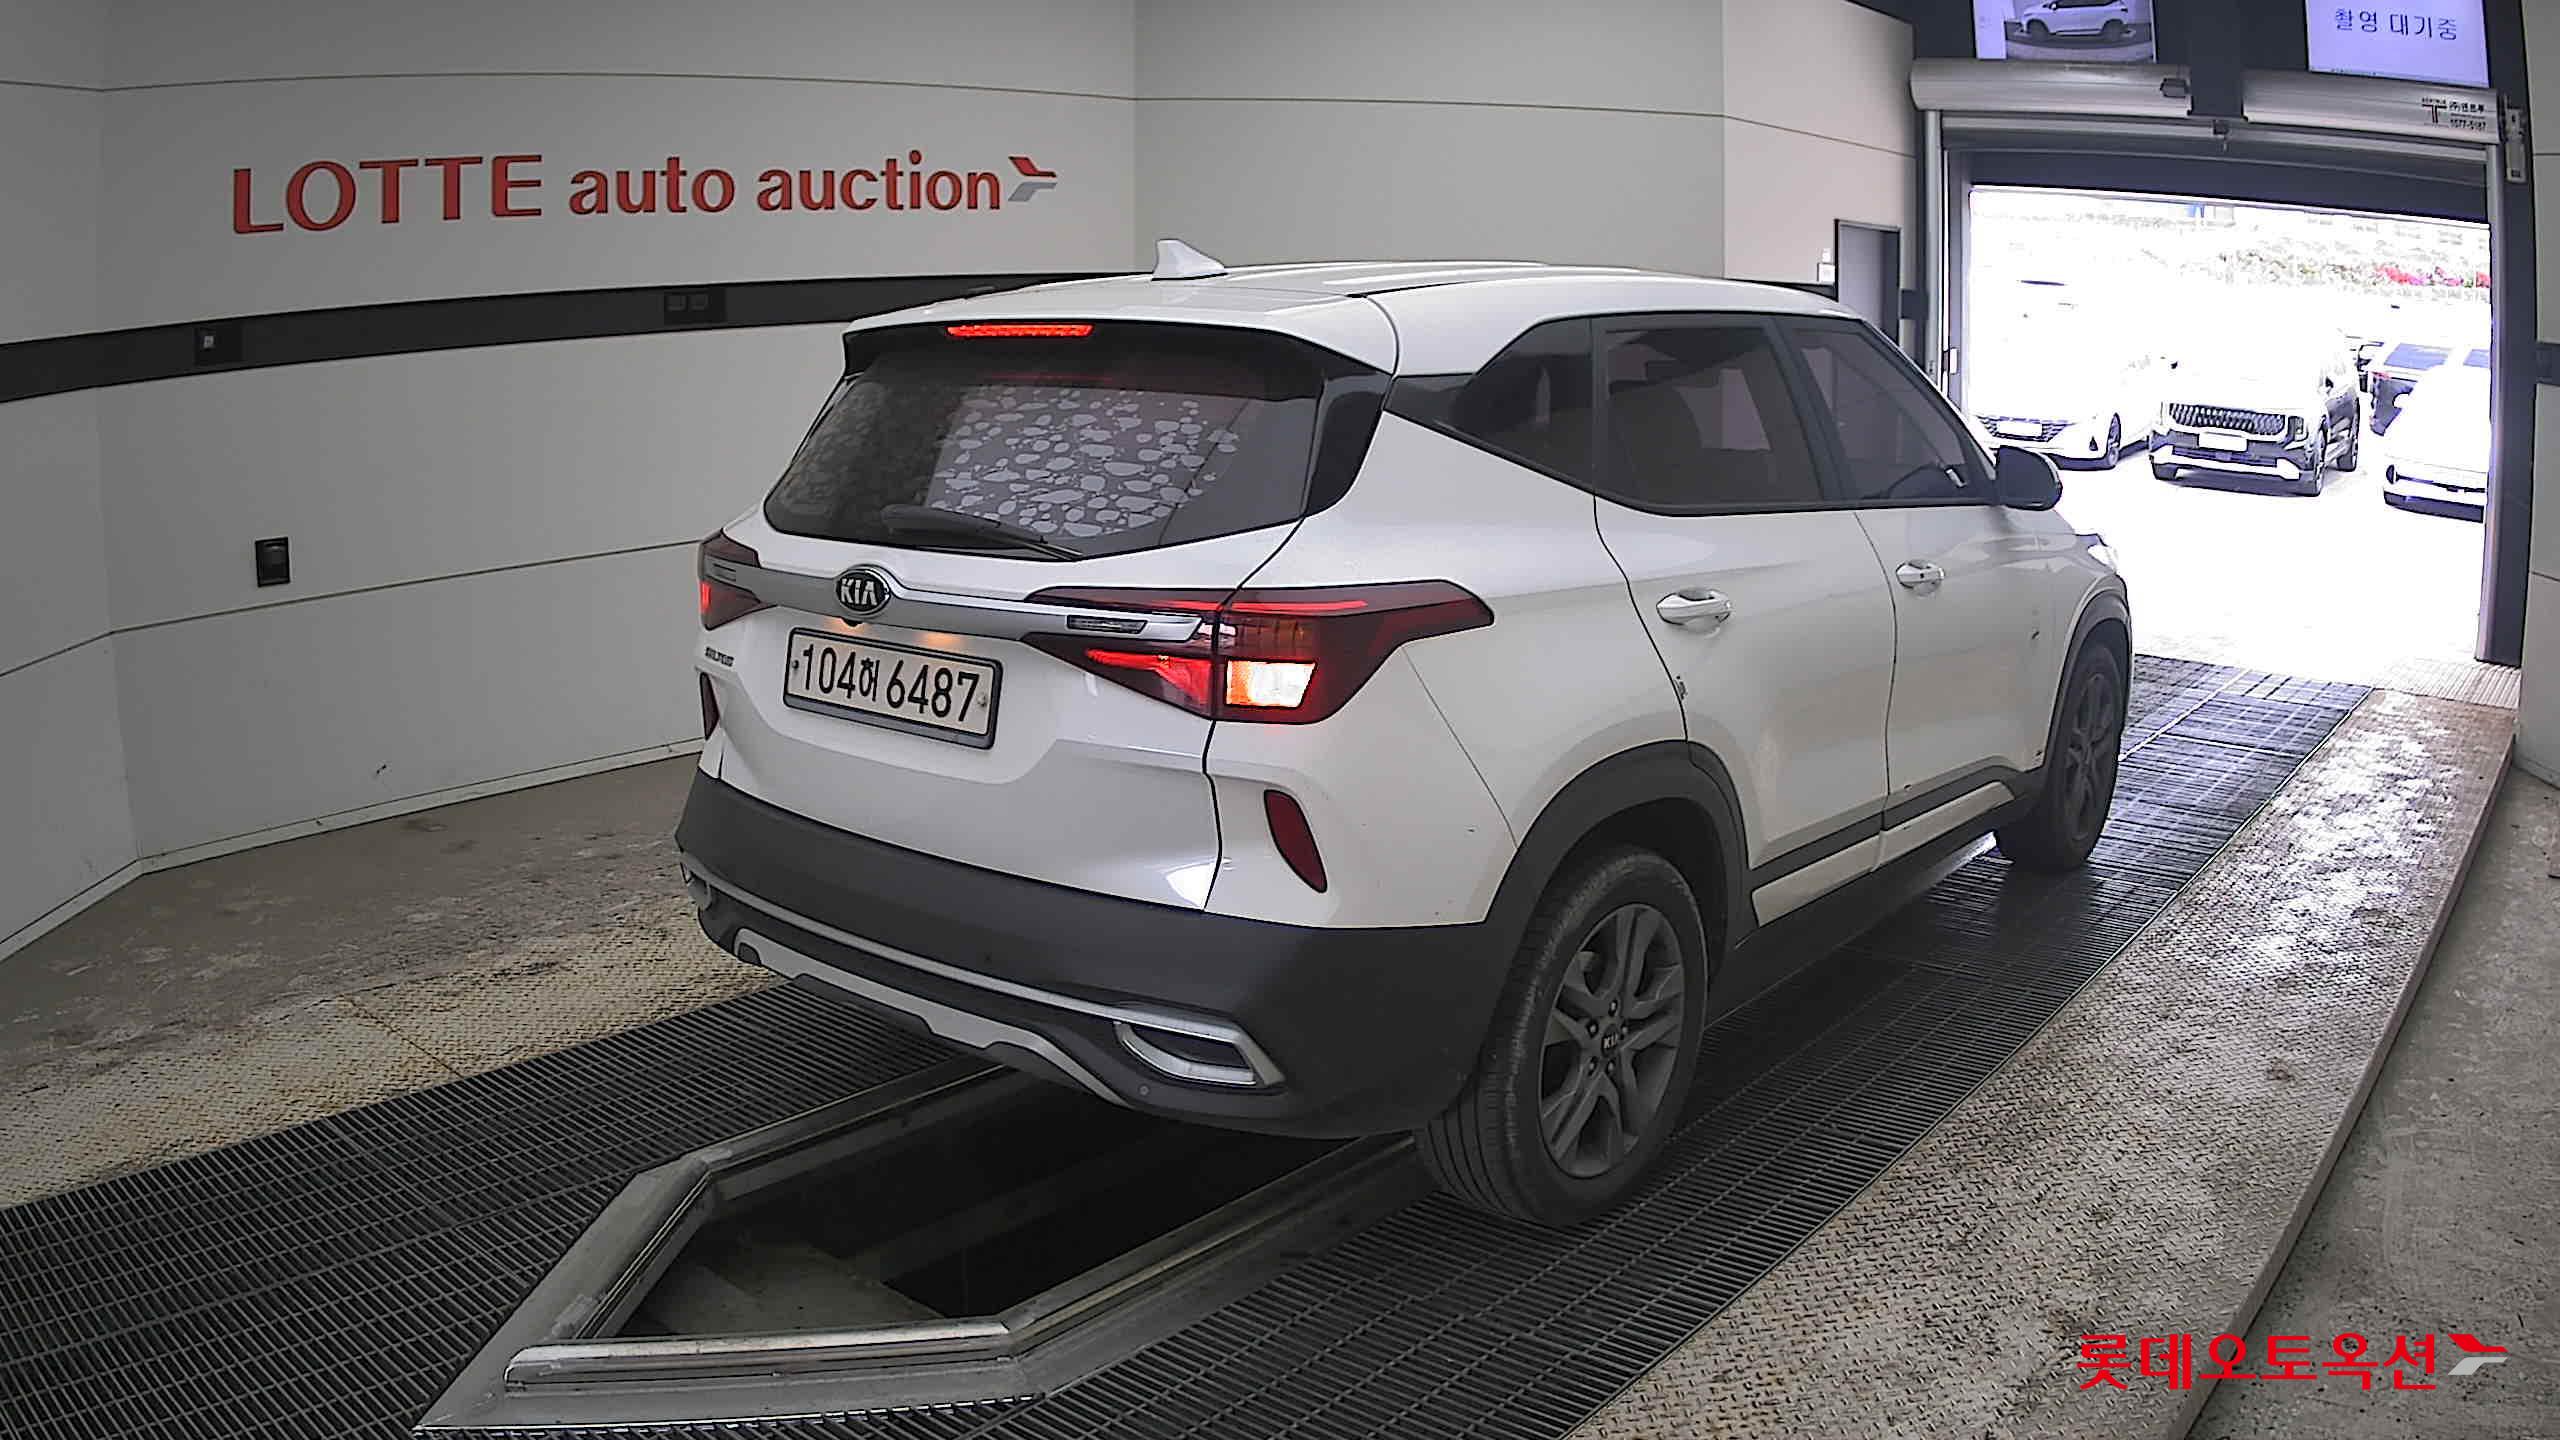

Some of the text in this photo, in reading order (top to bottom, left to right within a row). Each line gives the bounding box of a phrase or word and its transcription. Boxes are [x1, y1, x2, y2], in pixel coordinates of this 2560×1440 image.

[2335, 8, 2457, 40] 촬영 대기중
[234, 150, 1001, 235] LOTTE auto auction
[840, 577, 878, 606] KIA
